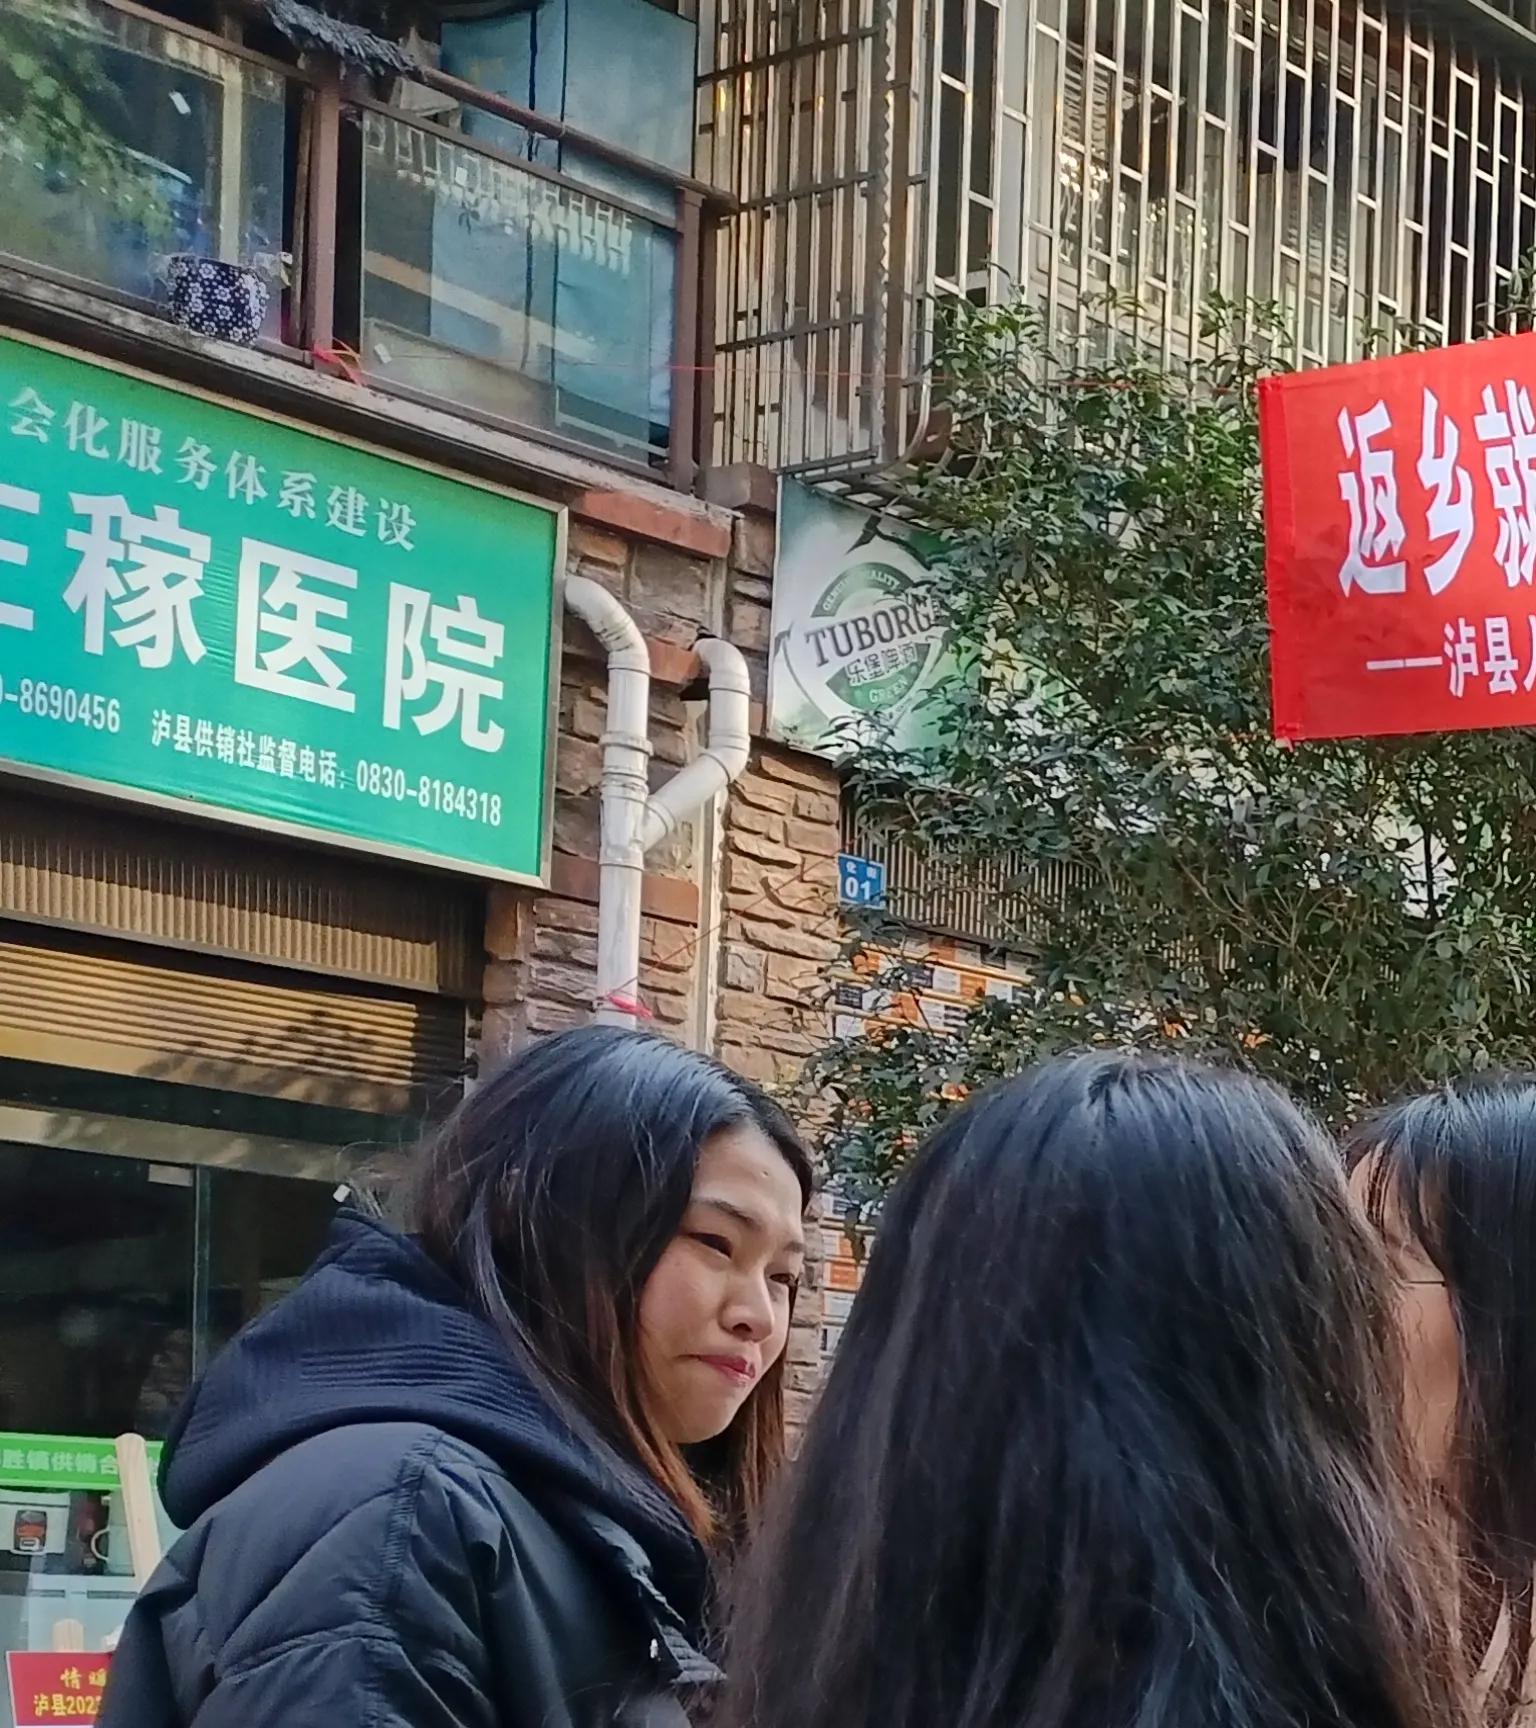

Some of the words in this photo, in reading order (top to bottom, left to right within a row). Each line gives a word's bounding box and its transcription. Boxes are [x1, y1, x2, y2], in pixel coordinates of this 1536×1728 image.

[9, 386, 419, 553] 会化服务体系建设
[33, 1693, 102, 1718] 泸县202
